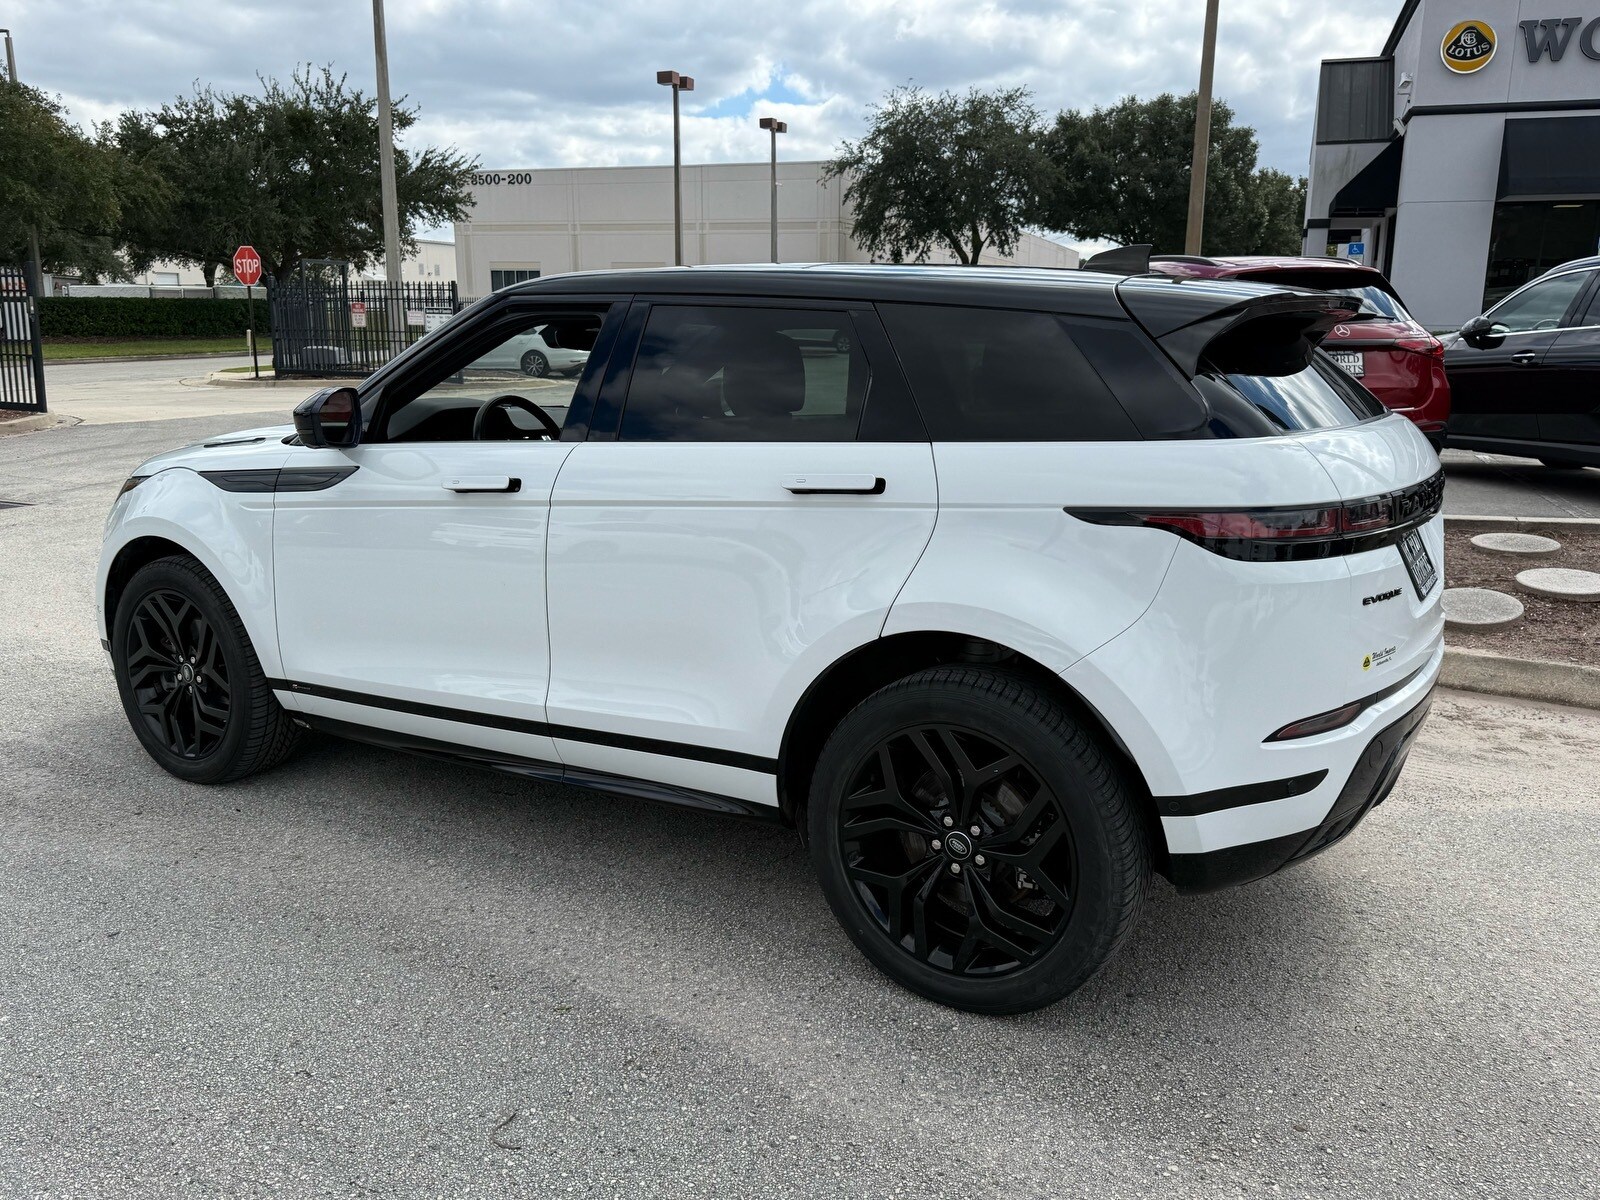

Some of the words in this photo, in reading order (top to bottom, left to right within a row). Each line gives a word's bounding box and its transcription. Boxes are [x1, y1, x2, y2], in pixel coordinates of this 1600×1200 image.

[1448, 42, 1490, 57] LOTUS
[471, 173, 532, 186] 8500-200
[236, 258, 259, 273] STOP
[1362, 587, 1402, 606] EVOQUE
